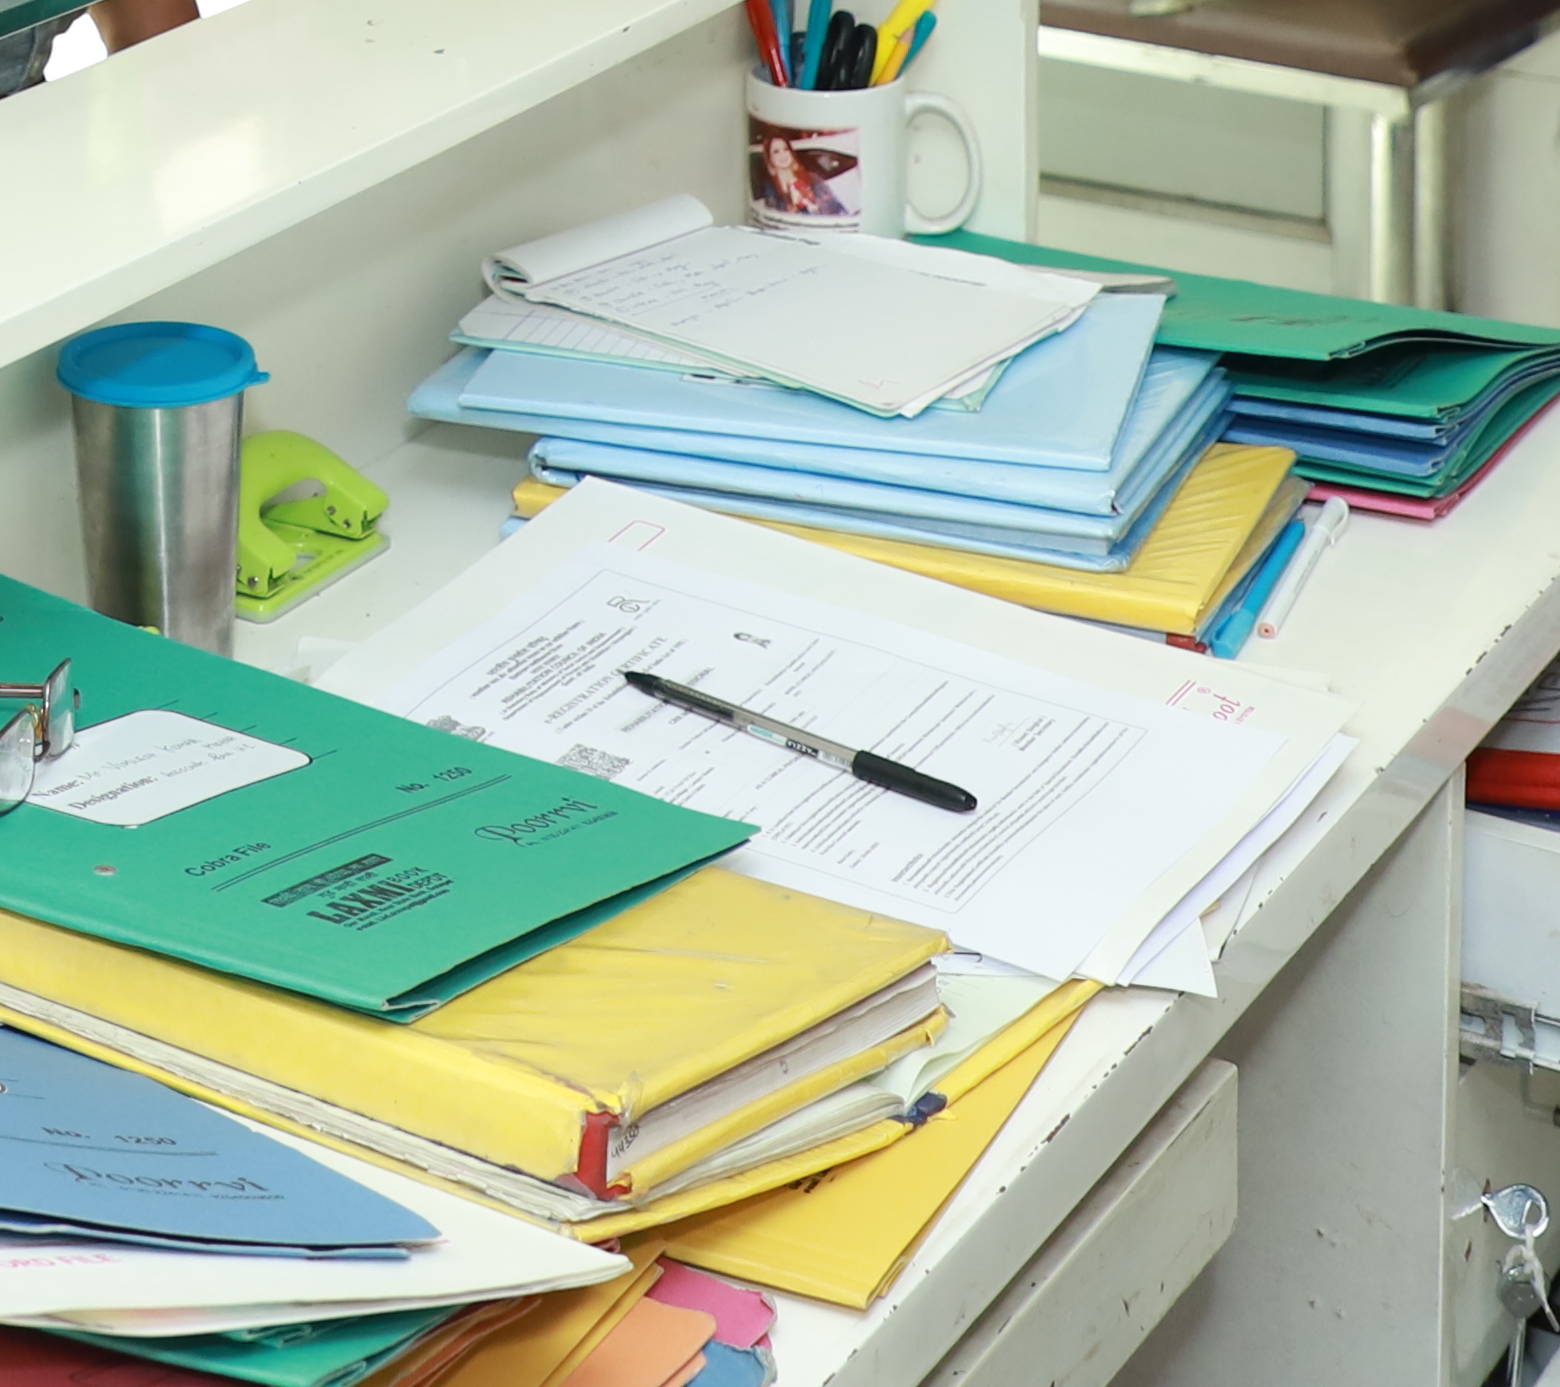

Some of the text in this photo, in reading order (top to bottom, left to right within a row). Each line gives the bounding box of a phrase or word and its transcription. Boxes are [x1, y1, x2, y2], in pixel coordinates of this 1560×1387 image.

[31, 778, 78, 803] Name:
[68, 775, 159, 812] Designation:
[395, 765, 475, 796] No. 1250
[184, 839, 273, 879] Cobra File
[307, 878, 418, 926] LAXMI
[114, 1134, 178, 1146] 1250
[56, 1253, 121, 1266] FILE
